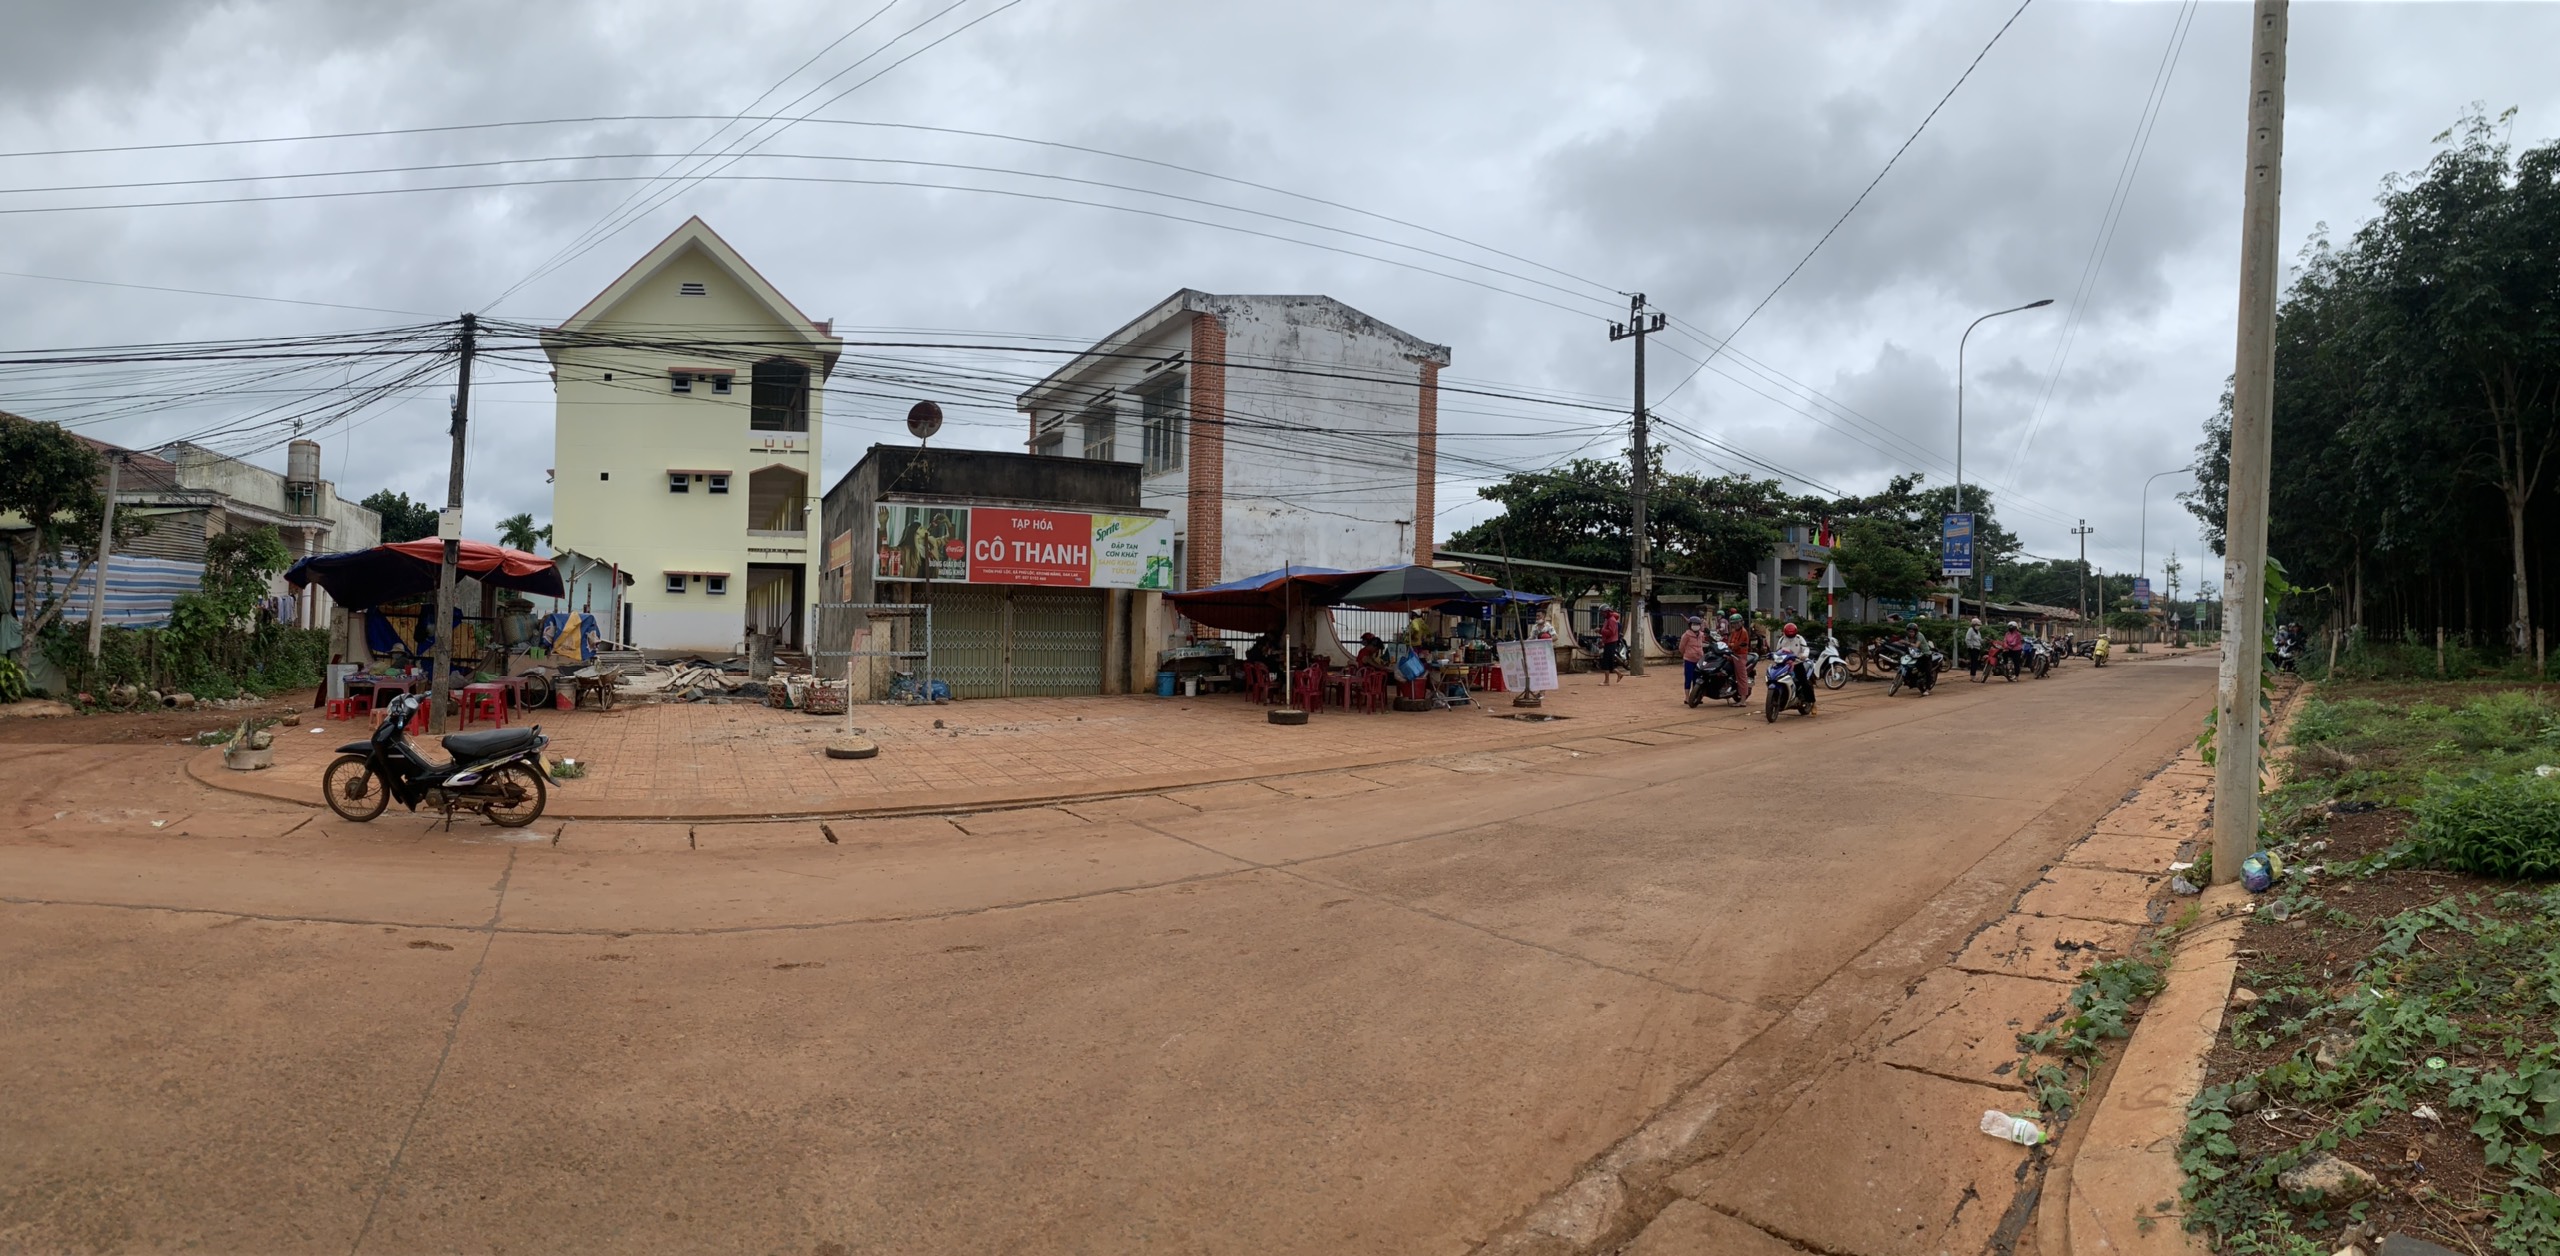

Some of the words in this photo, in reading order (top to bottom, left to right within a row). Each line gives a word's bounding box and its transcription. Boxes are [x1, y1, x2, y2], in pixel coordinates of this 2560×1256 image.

[1011, 518, 1030, 531] TẠP
[1032, 518, 1053, 531] HÓA
[1096, 522, 1120, 542] Sprite
[975, 535, 1005, 561] CÔ
[1011, 541, 1087, 566] THANH
